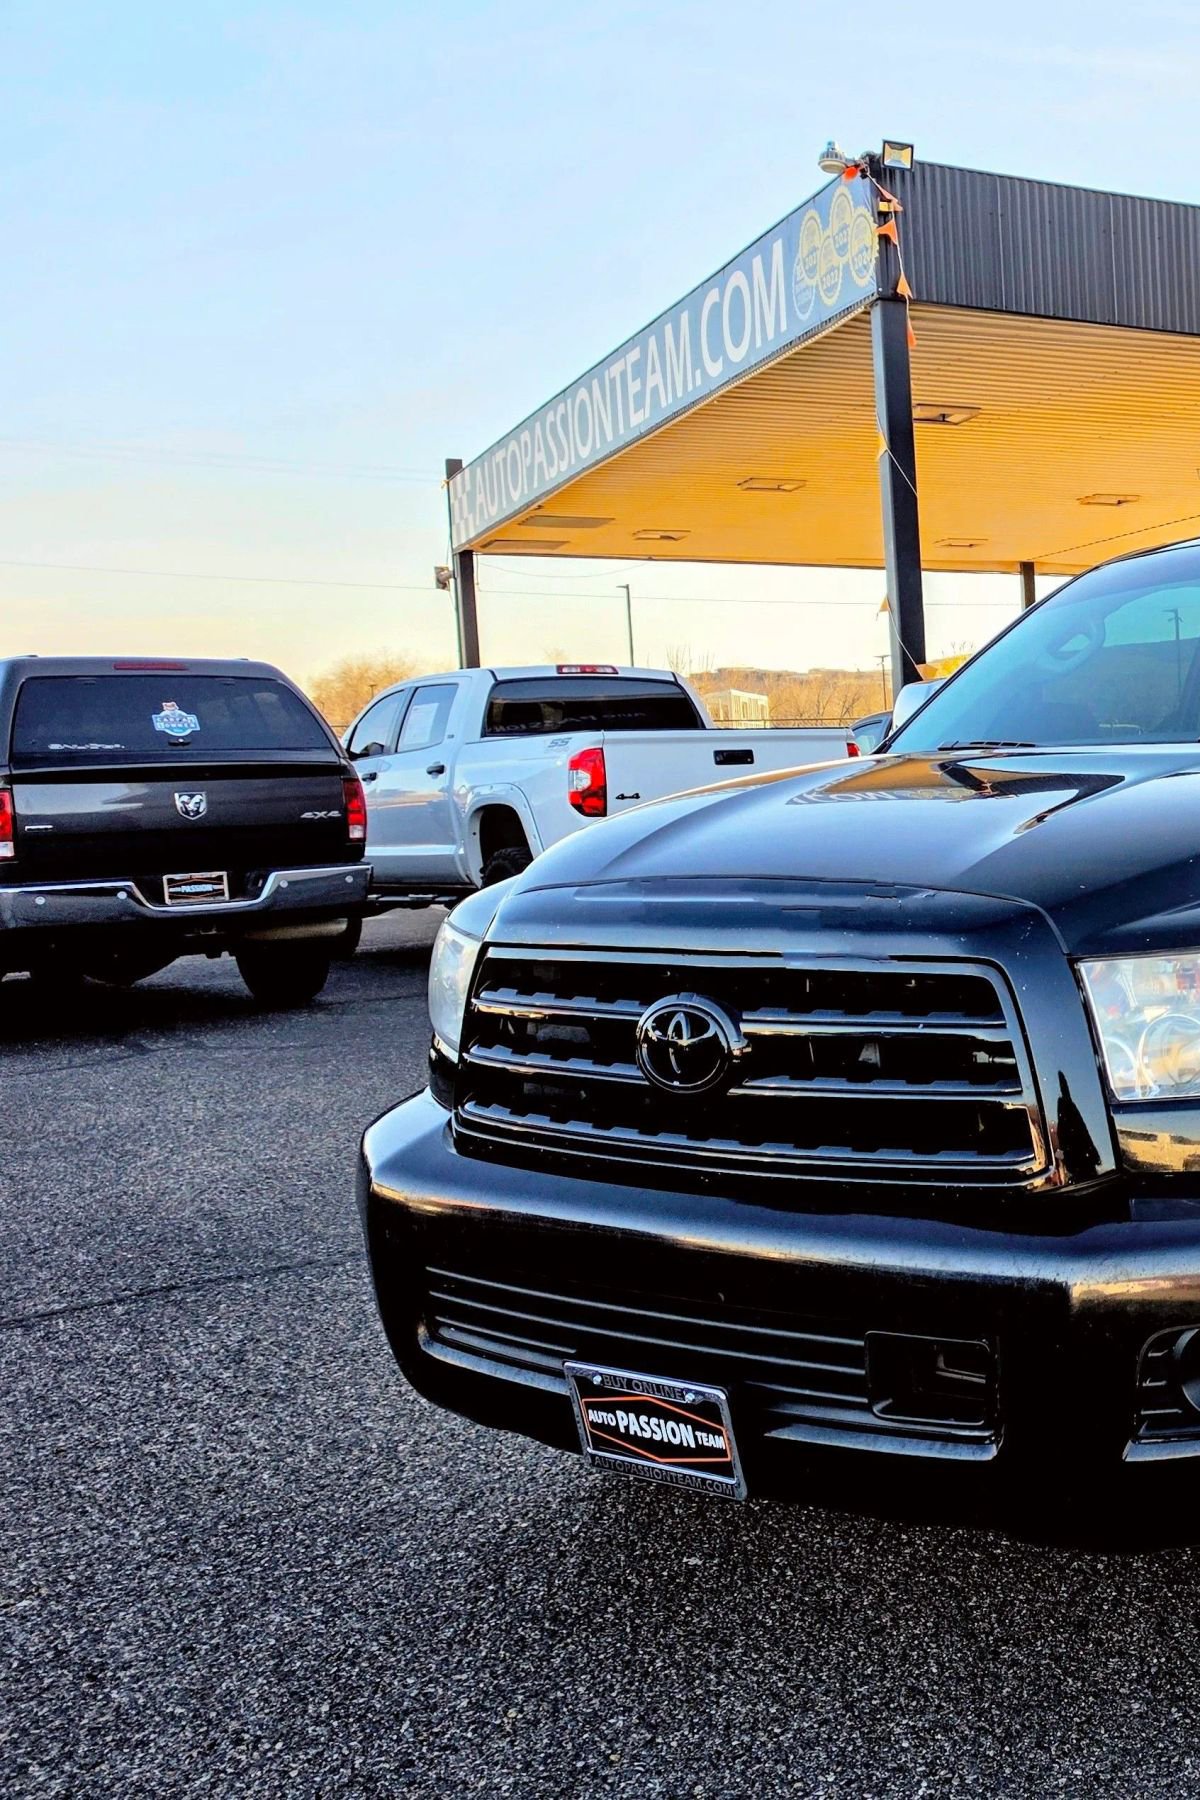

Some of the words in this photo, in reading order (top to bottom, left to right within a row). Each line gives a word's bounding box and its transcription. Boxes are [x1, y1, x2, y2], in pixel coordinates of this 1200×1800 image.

[475, 238, 788, 526] AUTOPASSIONTEAM.COM
[602, 1374, 628, 1388] BUY
[632, 1380, 685, 1400] ONLINE
[588, 1409, 616, 1426] AUTO
[616, 1410, 697, 1449] PASSION
[695, 1431, 727, 1450] TEAM
[594, 1456, 734, 1496] AUTOPASSIONTEAM.COM
